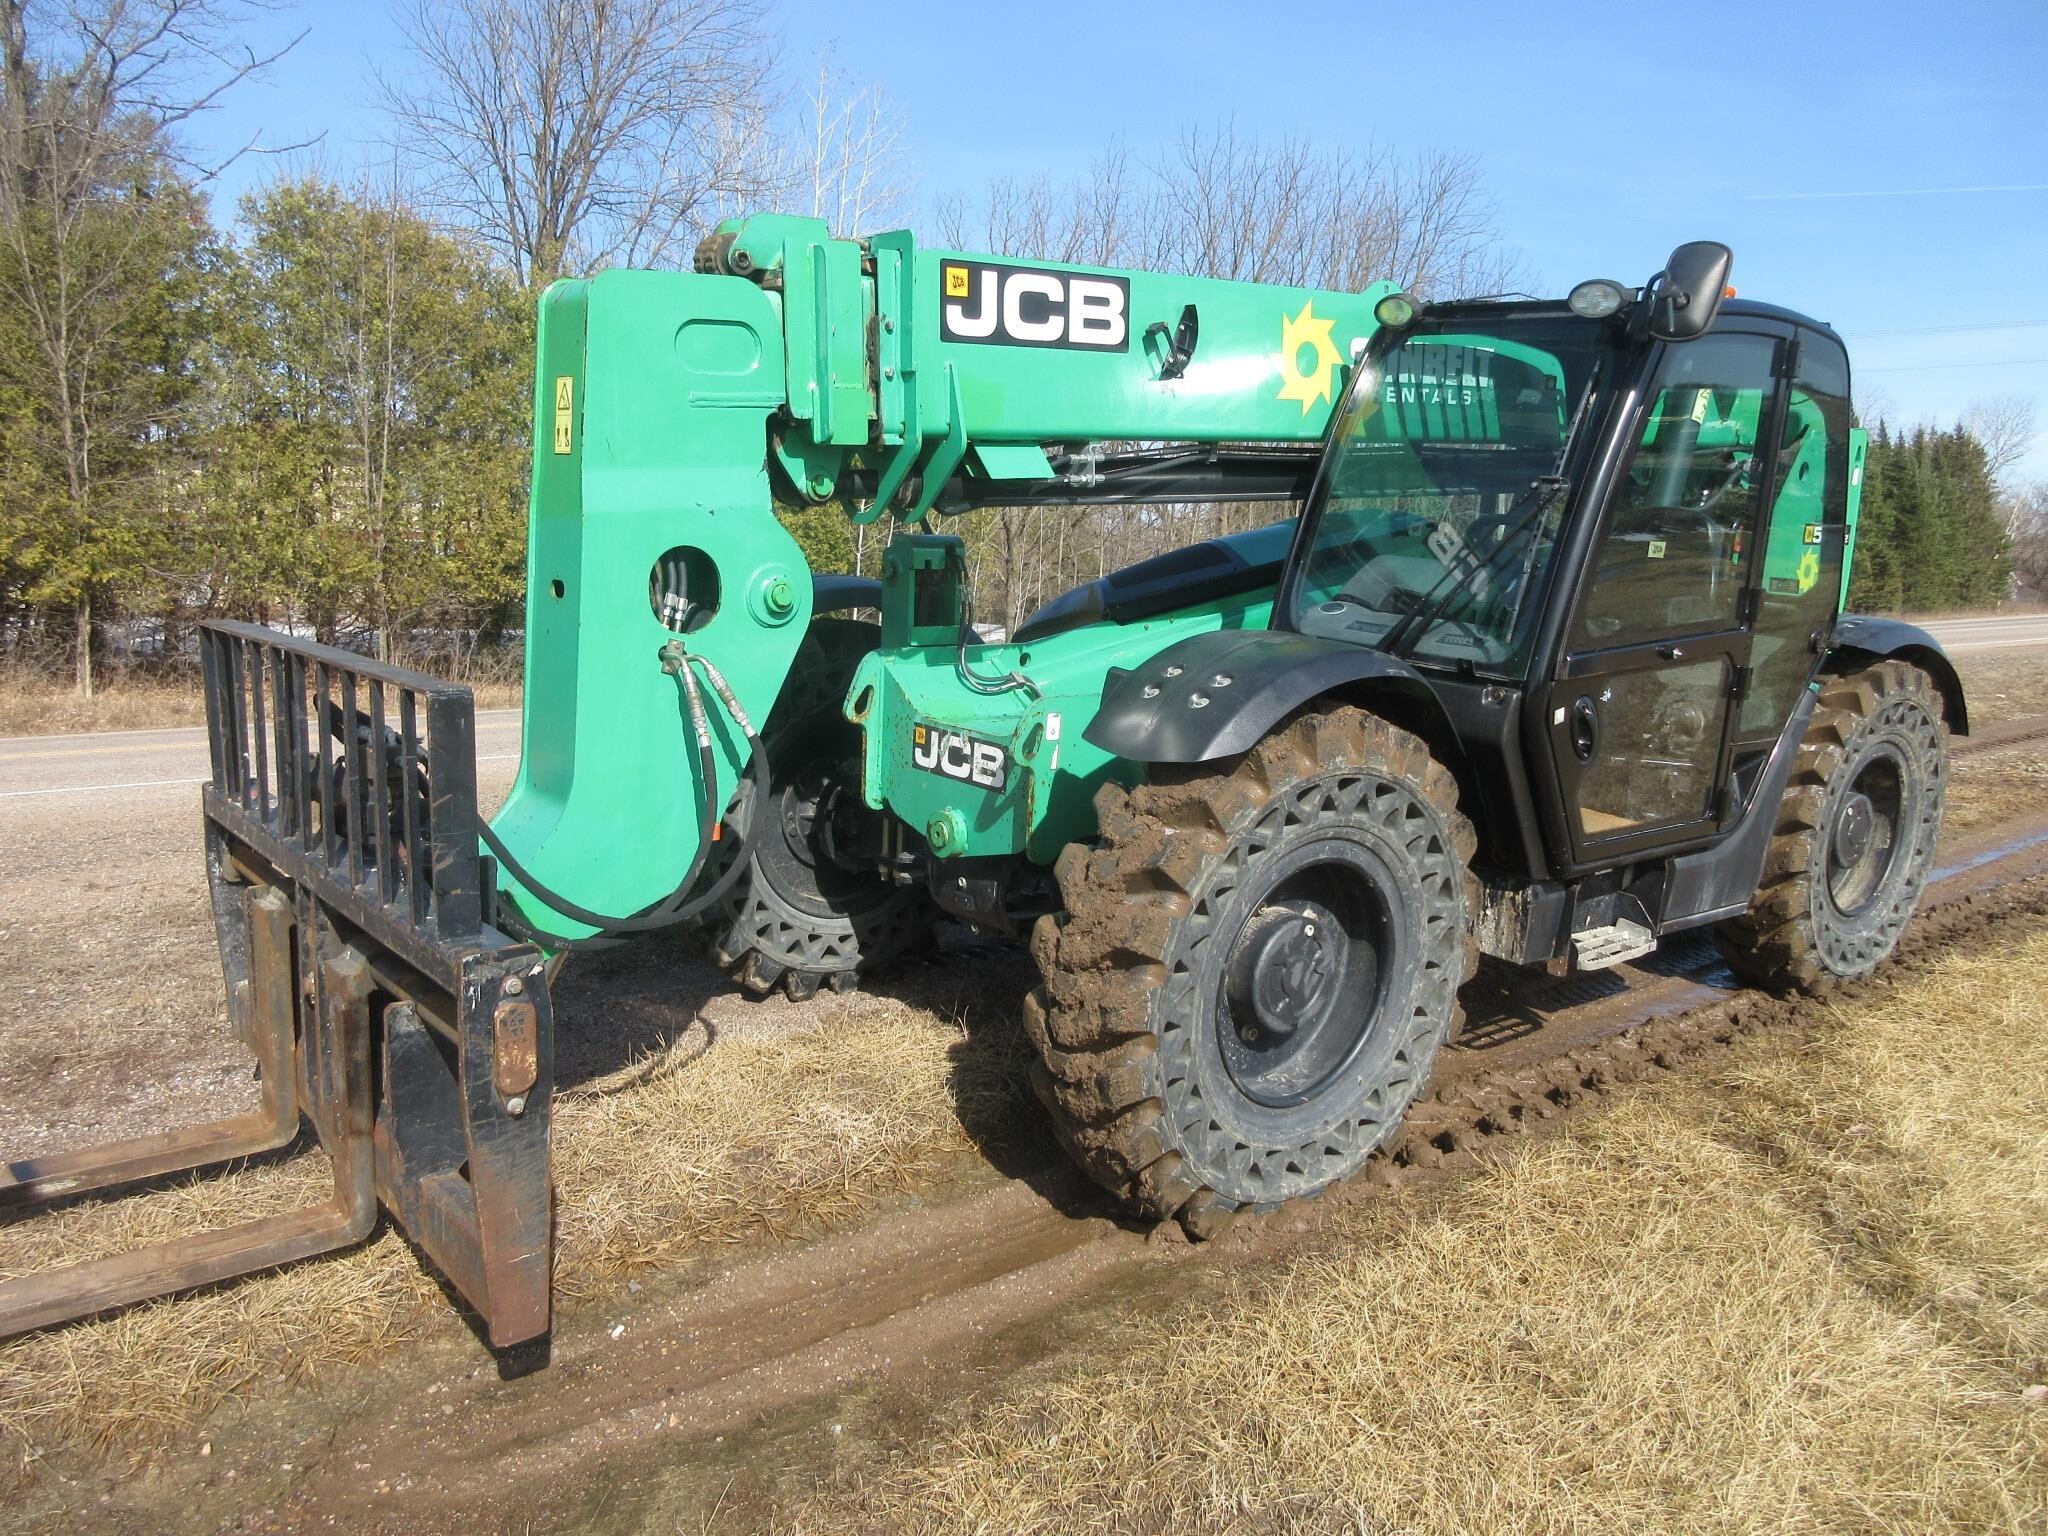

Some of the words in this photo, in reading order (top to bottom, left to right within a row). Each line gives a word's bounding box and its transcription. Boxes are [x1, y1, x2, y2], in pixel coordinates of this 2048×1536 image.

[946, 270, 1126, 345] JCB
[1384, 387, 1472, 405] ENTALS
[914, 731, 1005, 788] JCB
